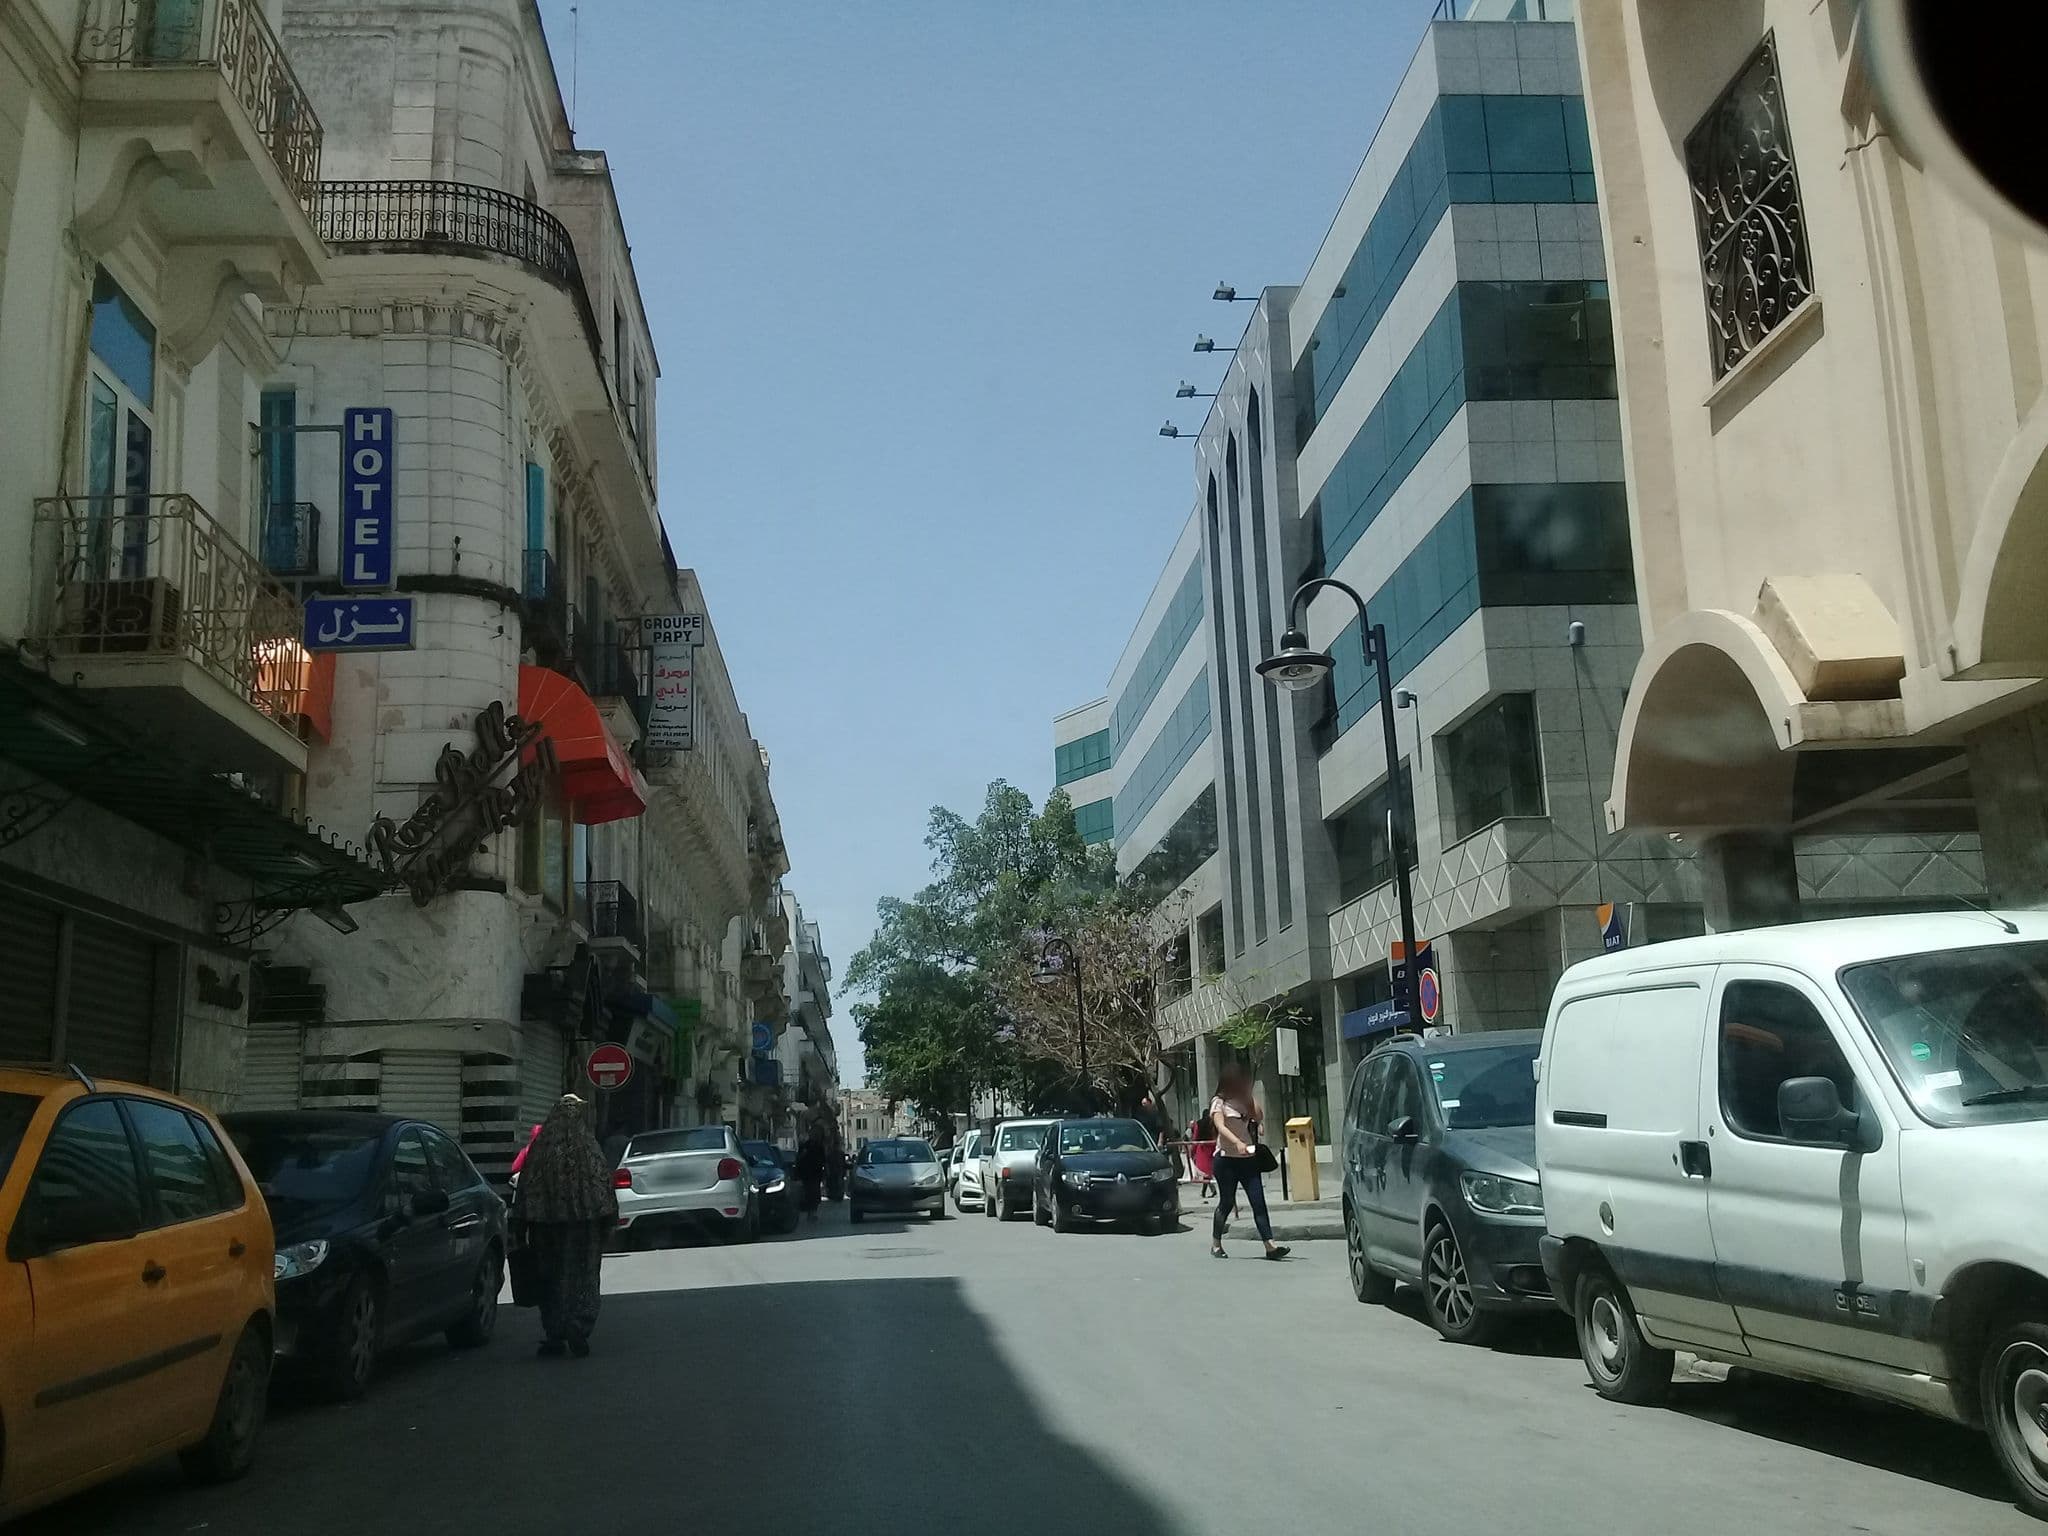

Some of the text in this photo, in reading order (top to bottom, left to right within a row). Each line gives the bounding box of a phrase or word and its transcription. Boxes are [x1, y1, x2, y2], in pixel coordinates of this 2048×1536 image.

[353, 414, 383, 580] HOTEL
[318, 604, 405, 643] نزل
[644, 616, 701, 629] GROUPE
[653, 631, 692, 643] PAPY
[655, 664, 690, 679] مصرف
[656, 683, 688, 701] بابي
[1605, 935, 1620, 948] BIAT
